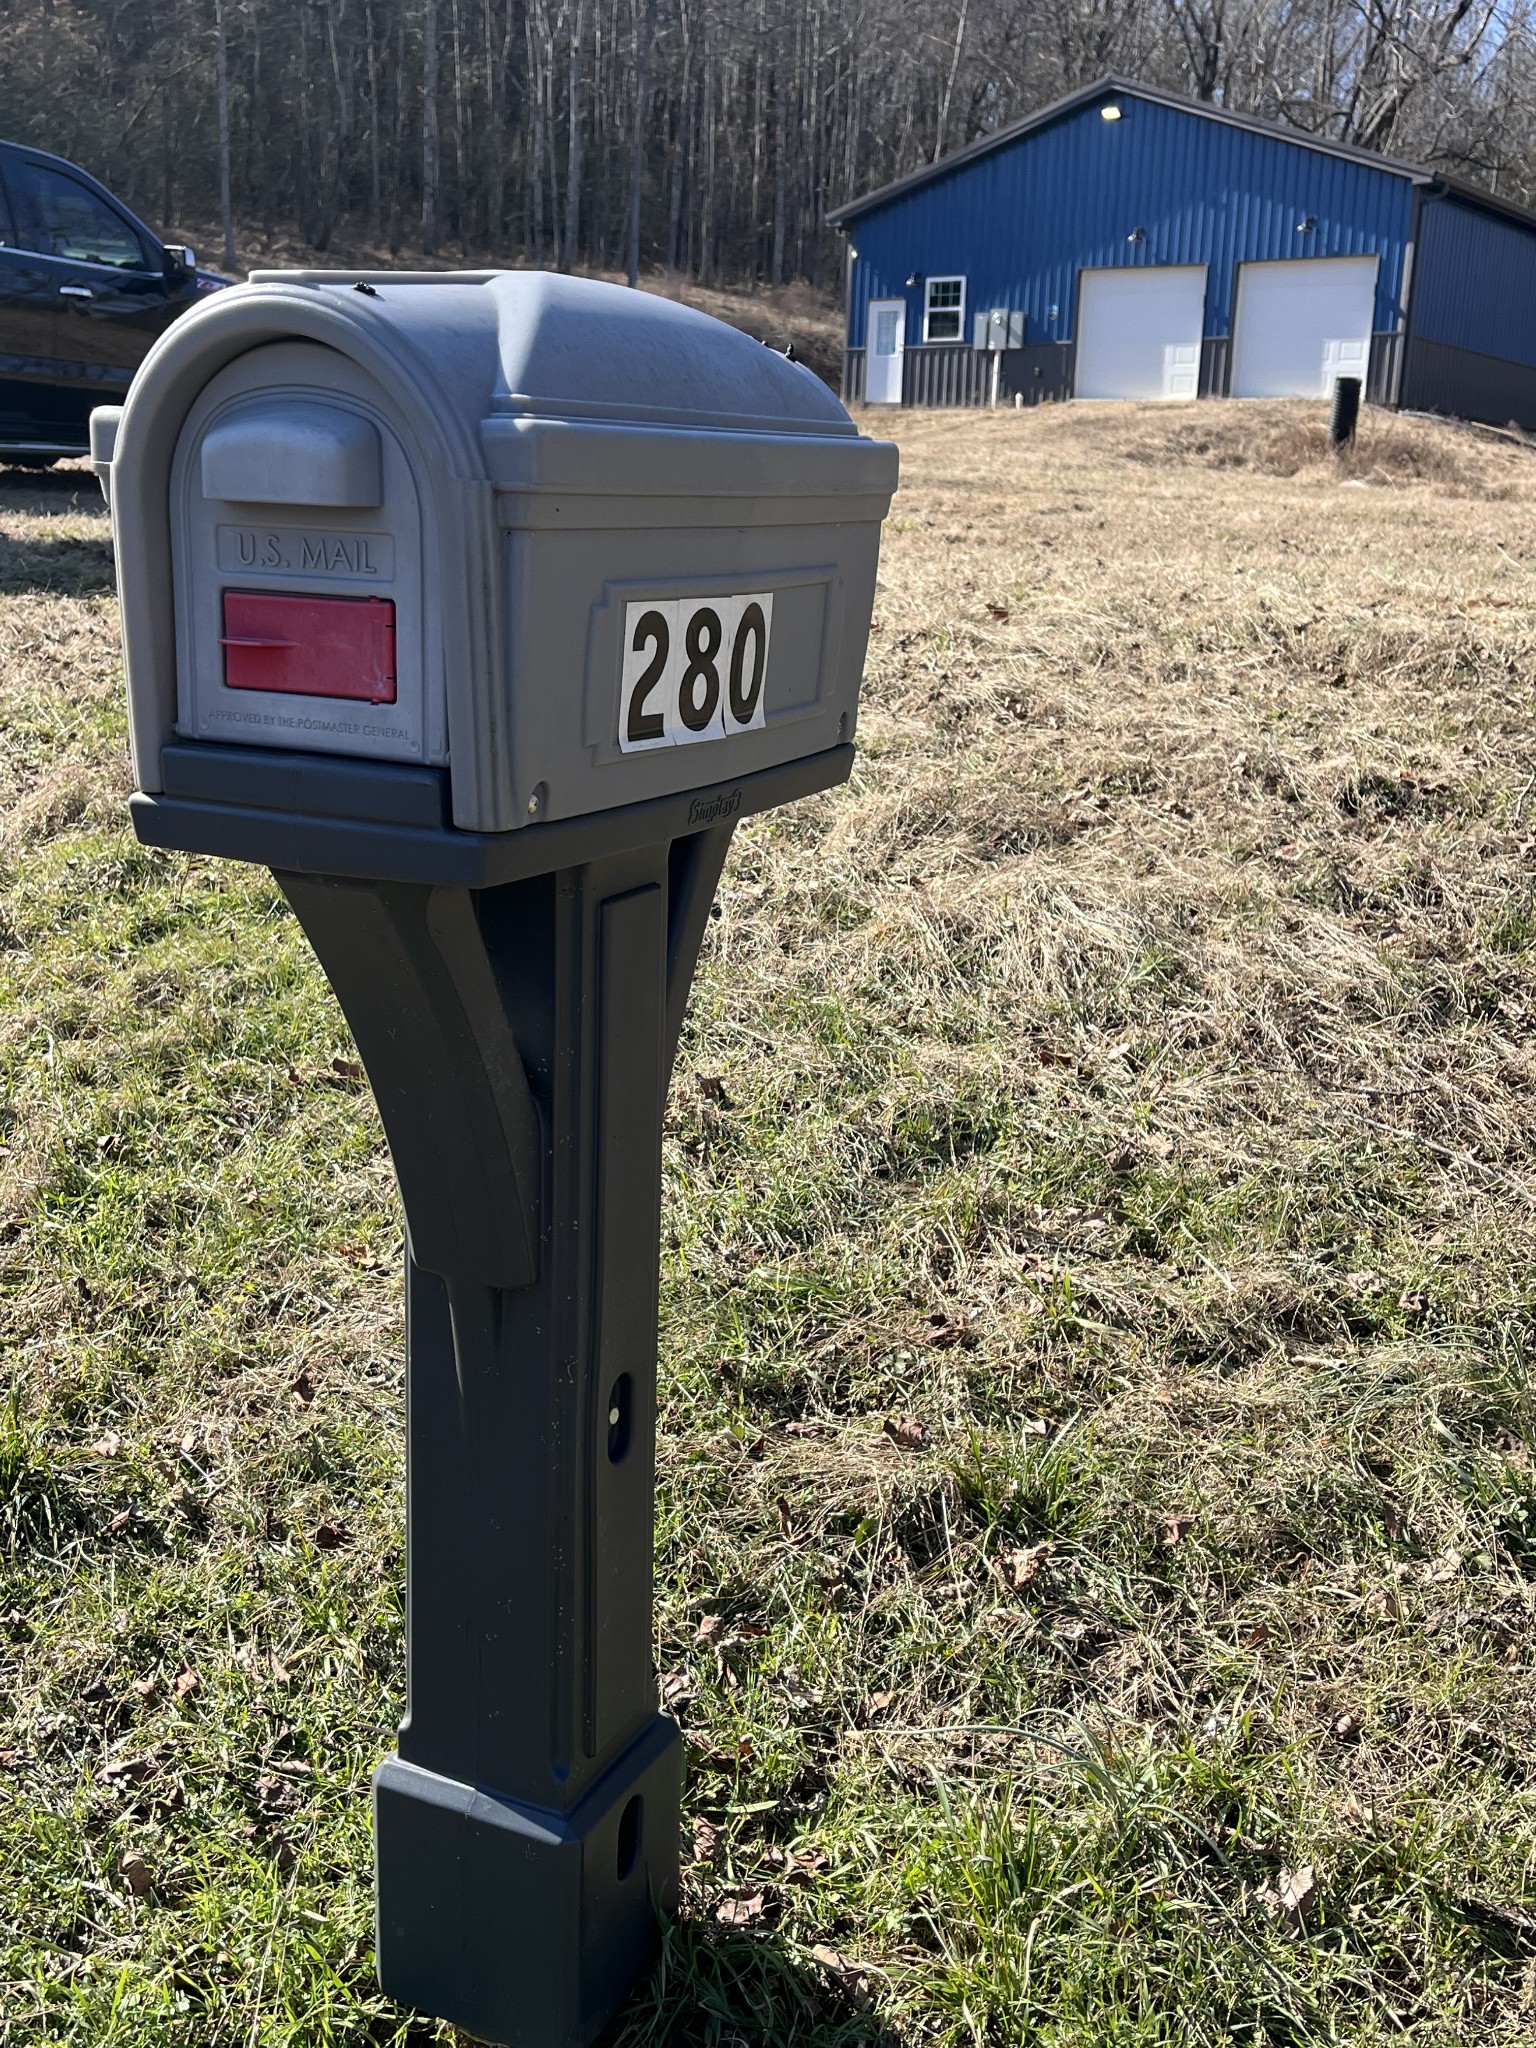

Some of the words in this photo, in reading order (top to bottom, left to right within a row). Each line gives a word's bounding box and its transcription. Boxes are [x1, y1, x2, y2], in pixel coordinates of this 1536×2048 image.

[237, 532, 290, 569] U.S.
[301, 536, 378, 575] MAIL
[627, 602, 766, 742] 280
[208, 710, 262, 725] APPROVED
[263, 714, 276, 726] BY
[279, 716, 297, 729] THE
[297, 718, 361, 735] POSTMASTER
[362, 725, 411, 741] GENERAL
